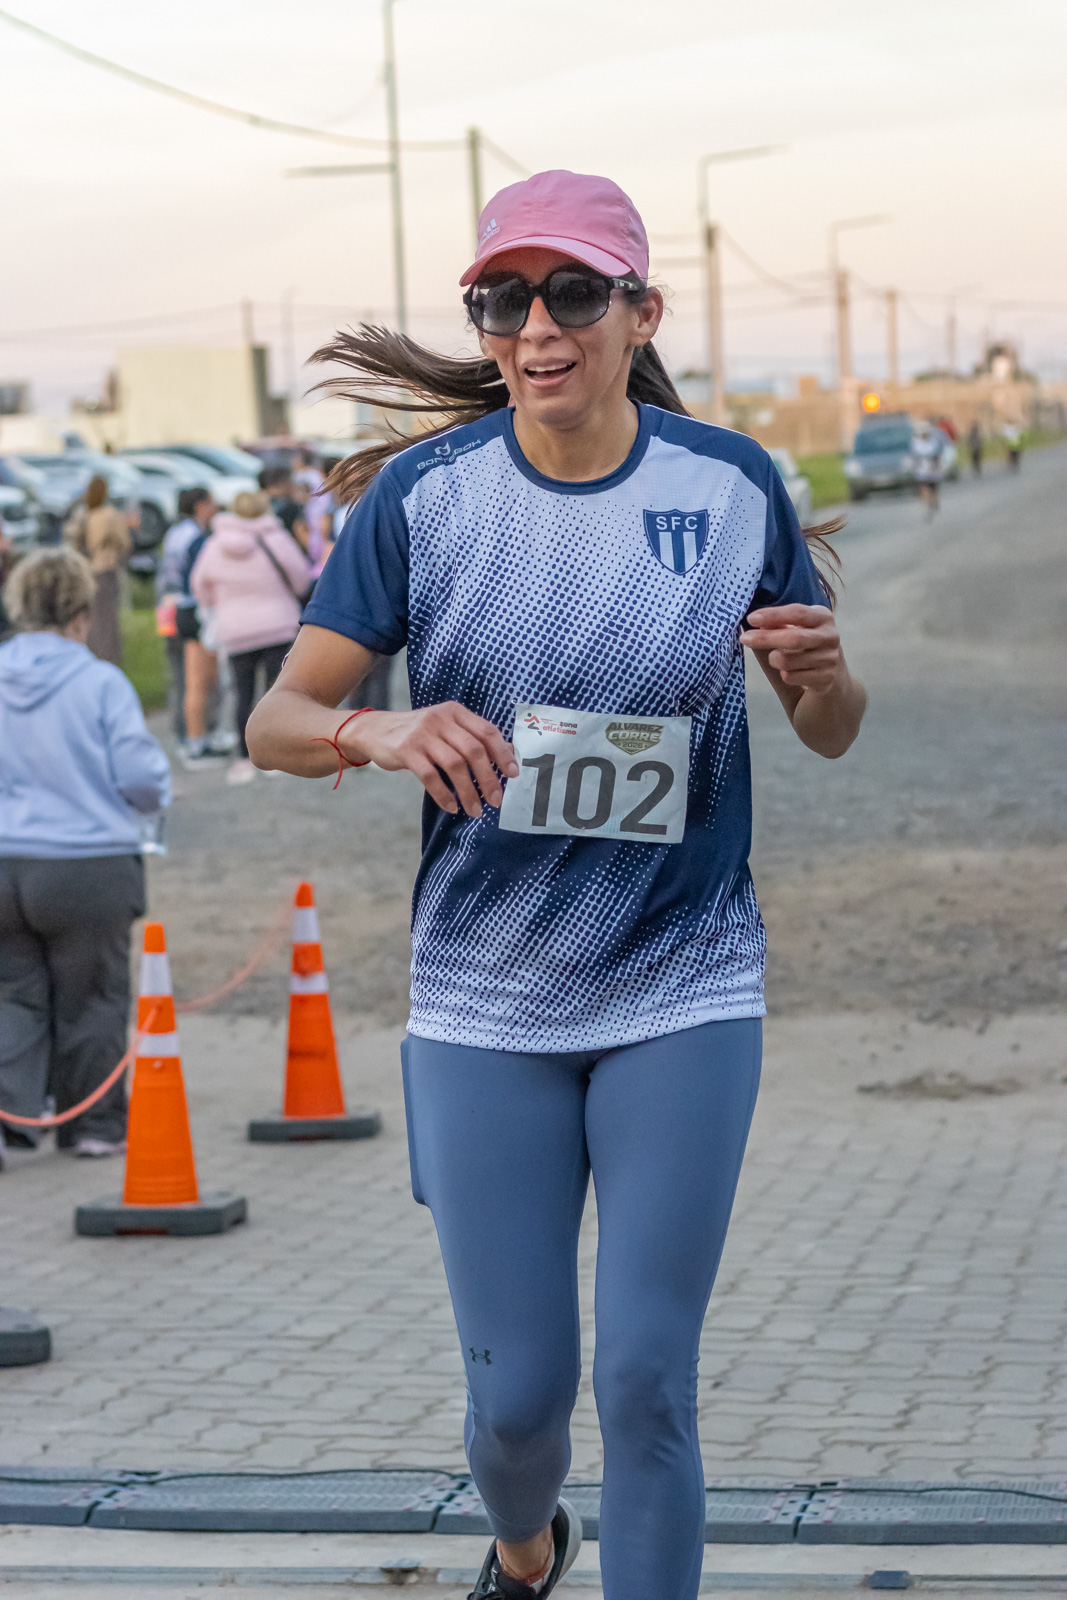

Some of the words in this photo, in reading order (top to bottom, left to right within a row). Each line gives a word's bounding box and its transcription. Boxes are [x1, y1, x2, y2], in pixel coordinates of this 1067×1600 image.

[656, 516, 698, 530] SFC
[542, 725, 577, 736] atletismo
[559, 721, 578, 729] zona
[609, 722, 664, 733] ALVAREZ
[608, 731, 661, 742] CORRE
[521, 753, 675, 836] 102
